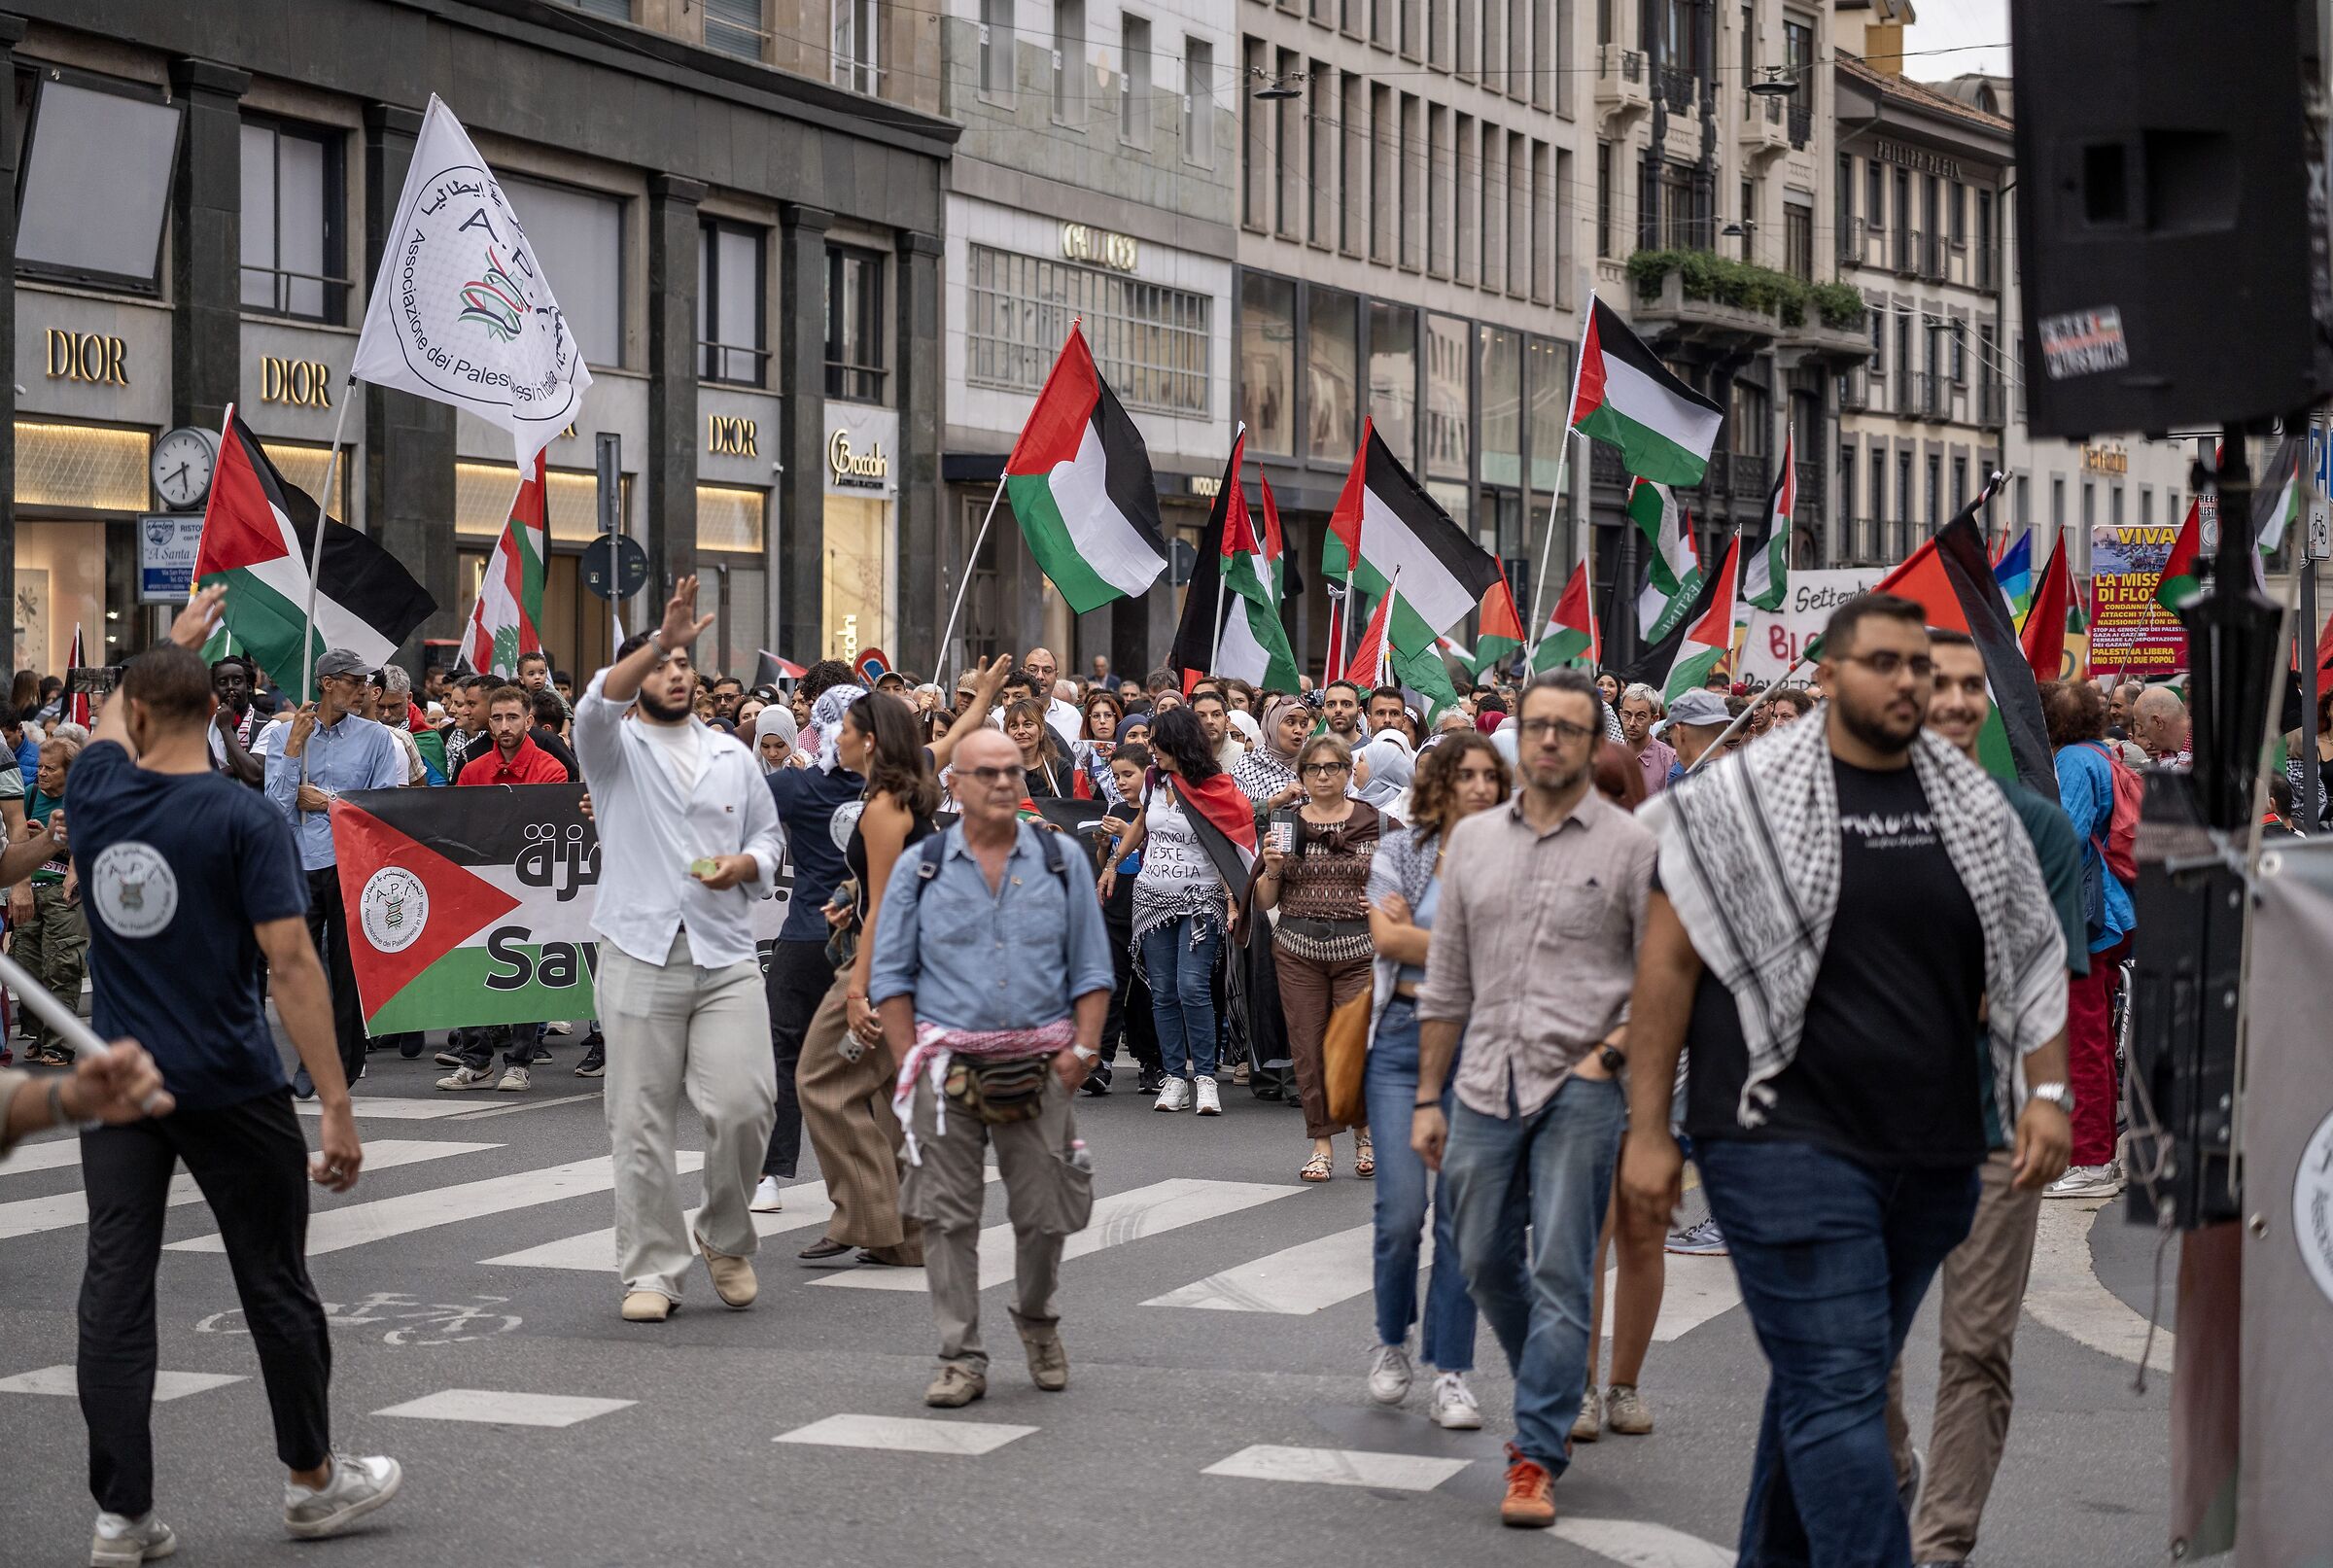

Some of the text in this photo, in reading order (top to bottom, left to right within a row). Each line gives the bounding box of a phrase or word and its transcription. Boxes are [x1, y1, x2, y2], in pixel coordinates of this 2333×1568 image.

[1877, 140, 1961, 180] PHILIPP PLEIN
[402, 228, 428, 350] Associazione
[427, 347, 454, 370] dei
[47, 328, 129, 386] DIOR
[261, 356, 332, 408] DIOR
[709, 414, 758, 459] DIOR
[2198, 495, 2215, 504] REE
[2116, 528, 2177, 544] VIVA
[2095, 573, 2116, 587] LA
[2098, 588, 2114, 602] DI
[239, 710, 253, 749] STIN
[392, 925, 418, 948] Palestinesi
